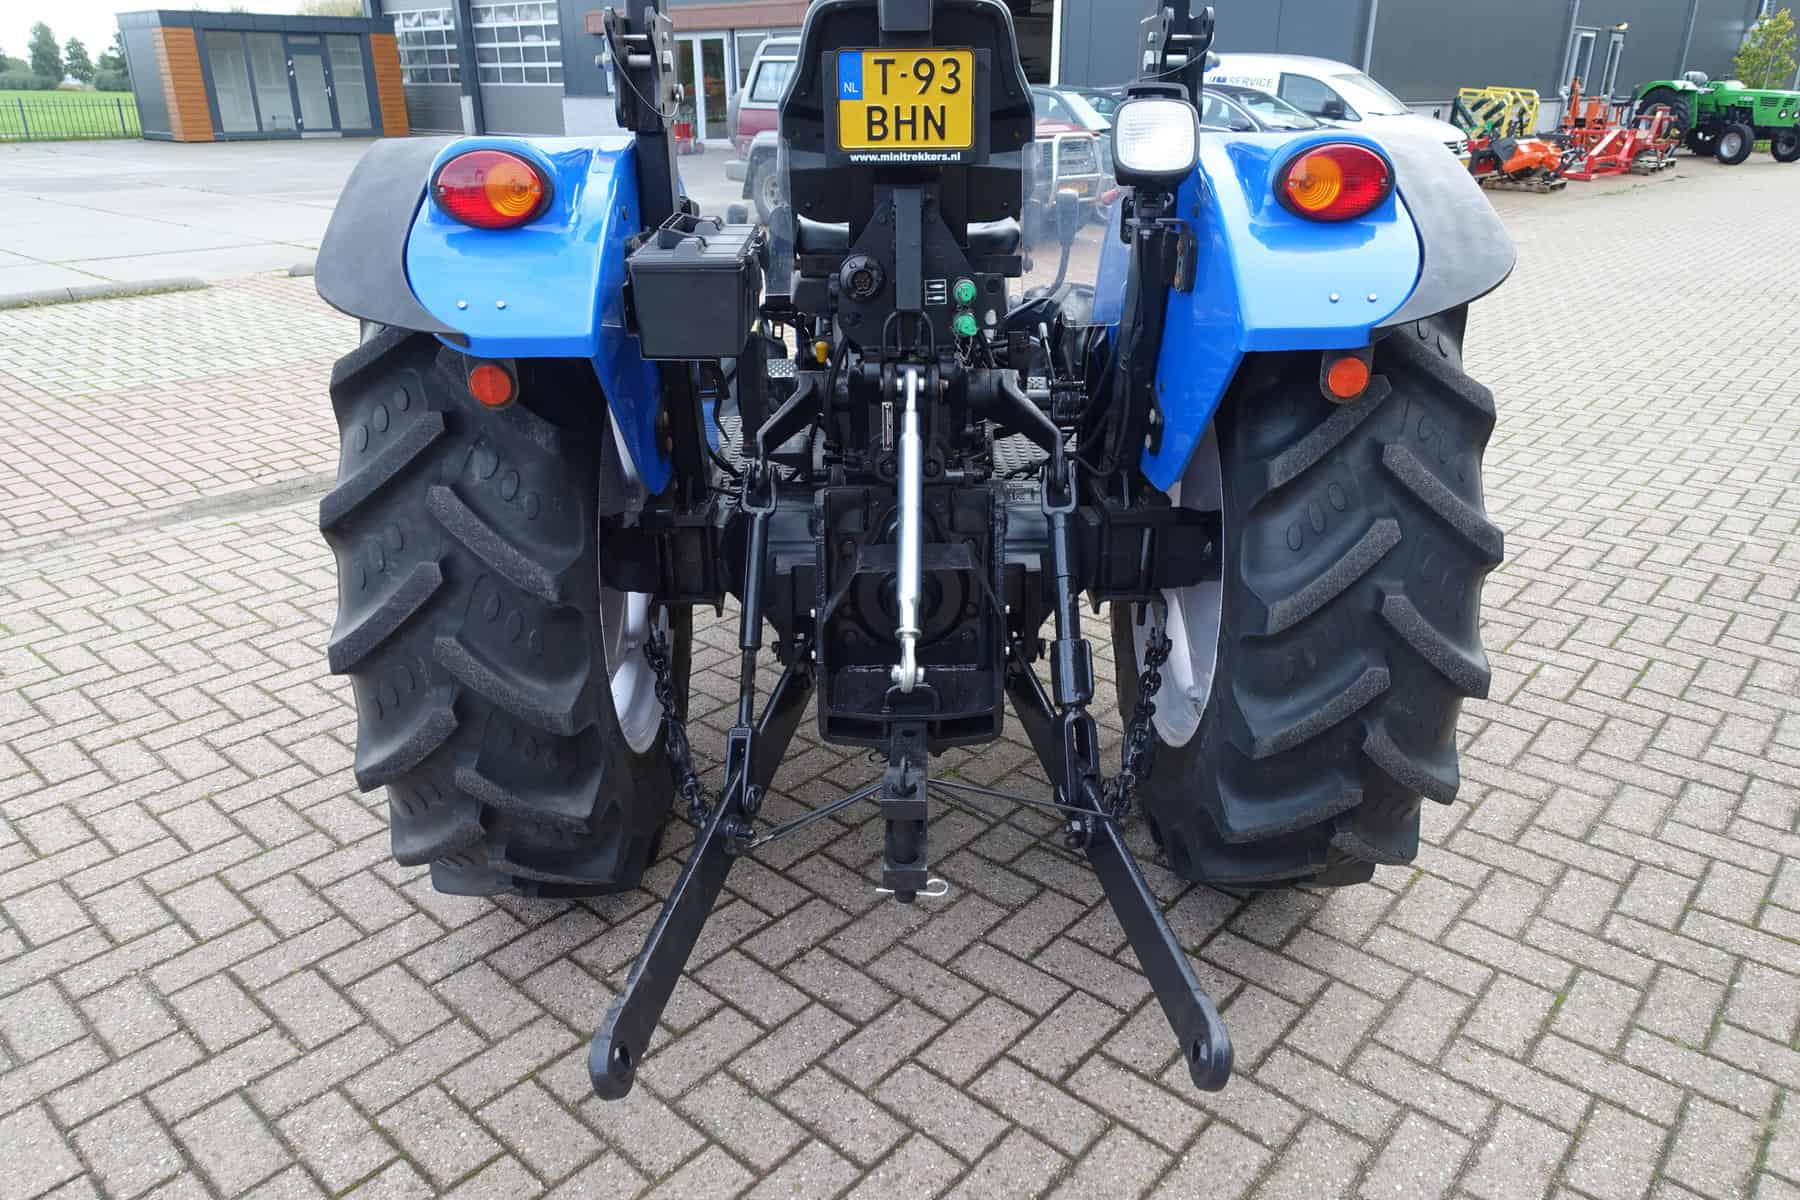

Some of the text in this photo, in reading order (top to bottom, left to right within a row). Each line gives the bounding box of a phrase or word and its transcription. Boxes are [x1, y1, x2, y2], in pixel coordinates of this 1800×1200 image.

[873, 58, 961, 96] T-93
[1229, 76, 1273, 88] SERVICE
[843, 82, 859, 93] NL
[866, 105, 946, 142] BHN
[849, 152, 961, 162] www.minitrekkers.nl
